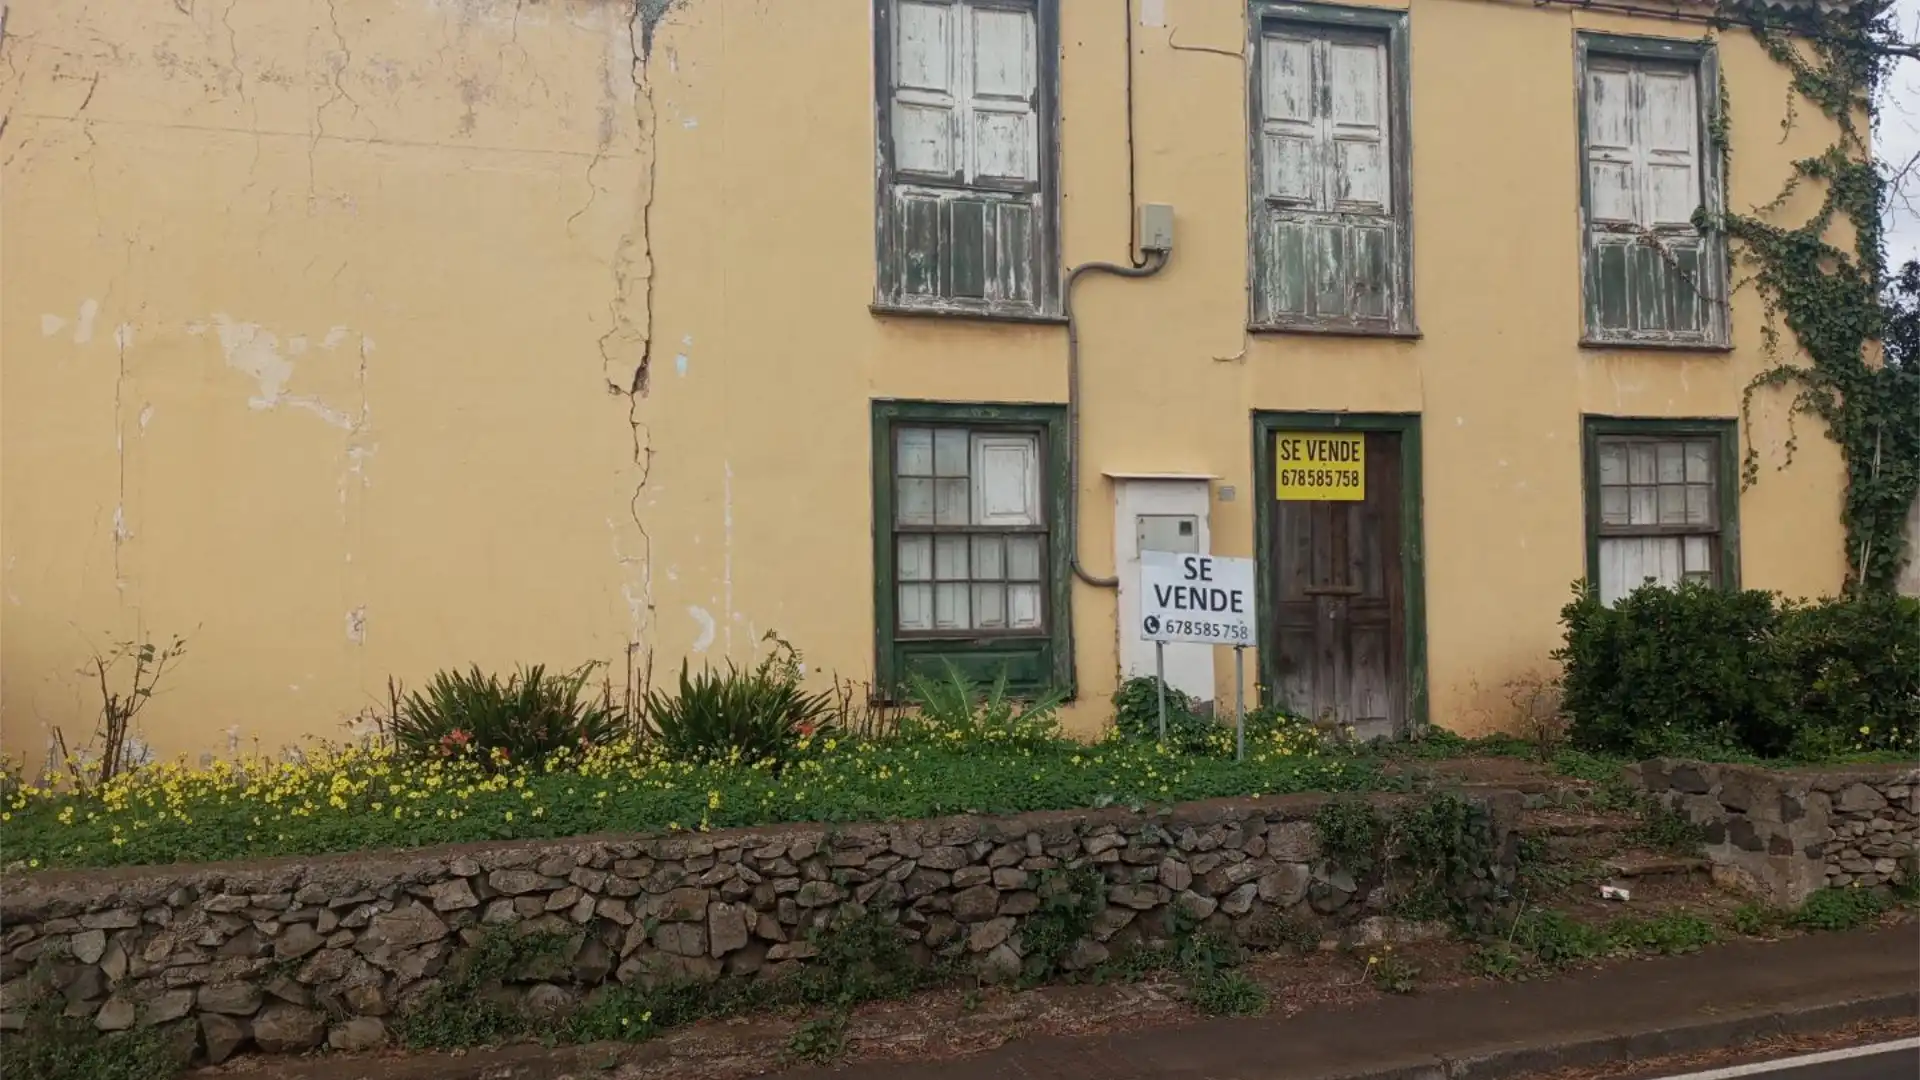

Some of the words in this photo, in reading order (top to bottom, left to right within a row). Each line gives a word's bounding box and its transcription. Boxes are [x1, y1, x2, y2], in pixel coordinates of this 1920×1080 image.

[1281, 439, 1301, 461] SE
[1306, 440, 1361, 462] VENDE
[1281, 469, 1360, 487] 678585758
[1184, 556, 1213, 581] SE
[1154, 583, 1244, 613] VENDE
[1166, 620, 1248, 640] 678585758
